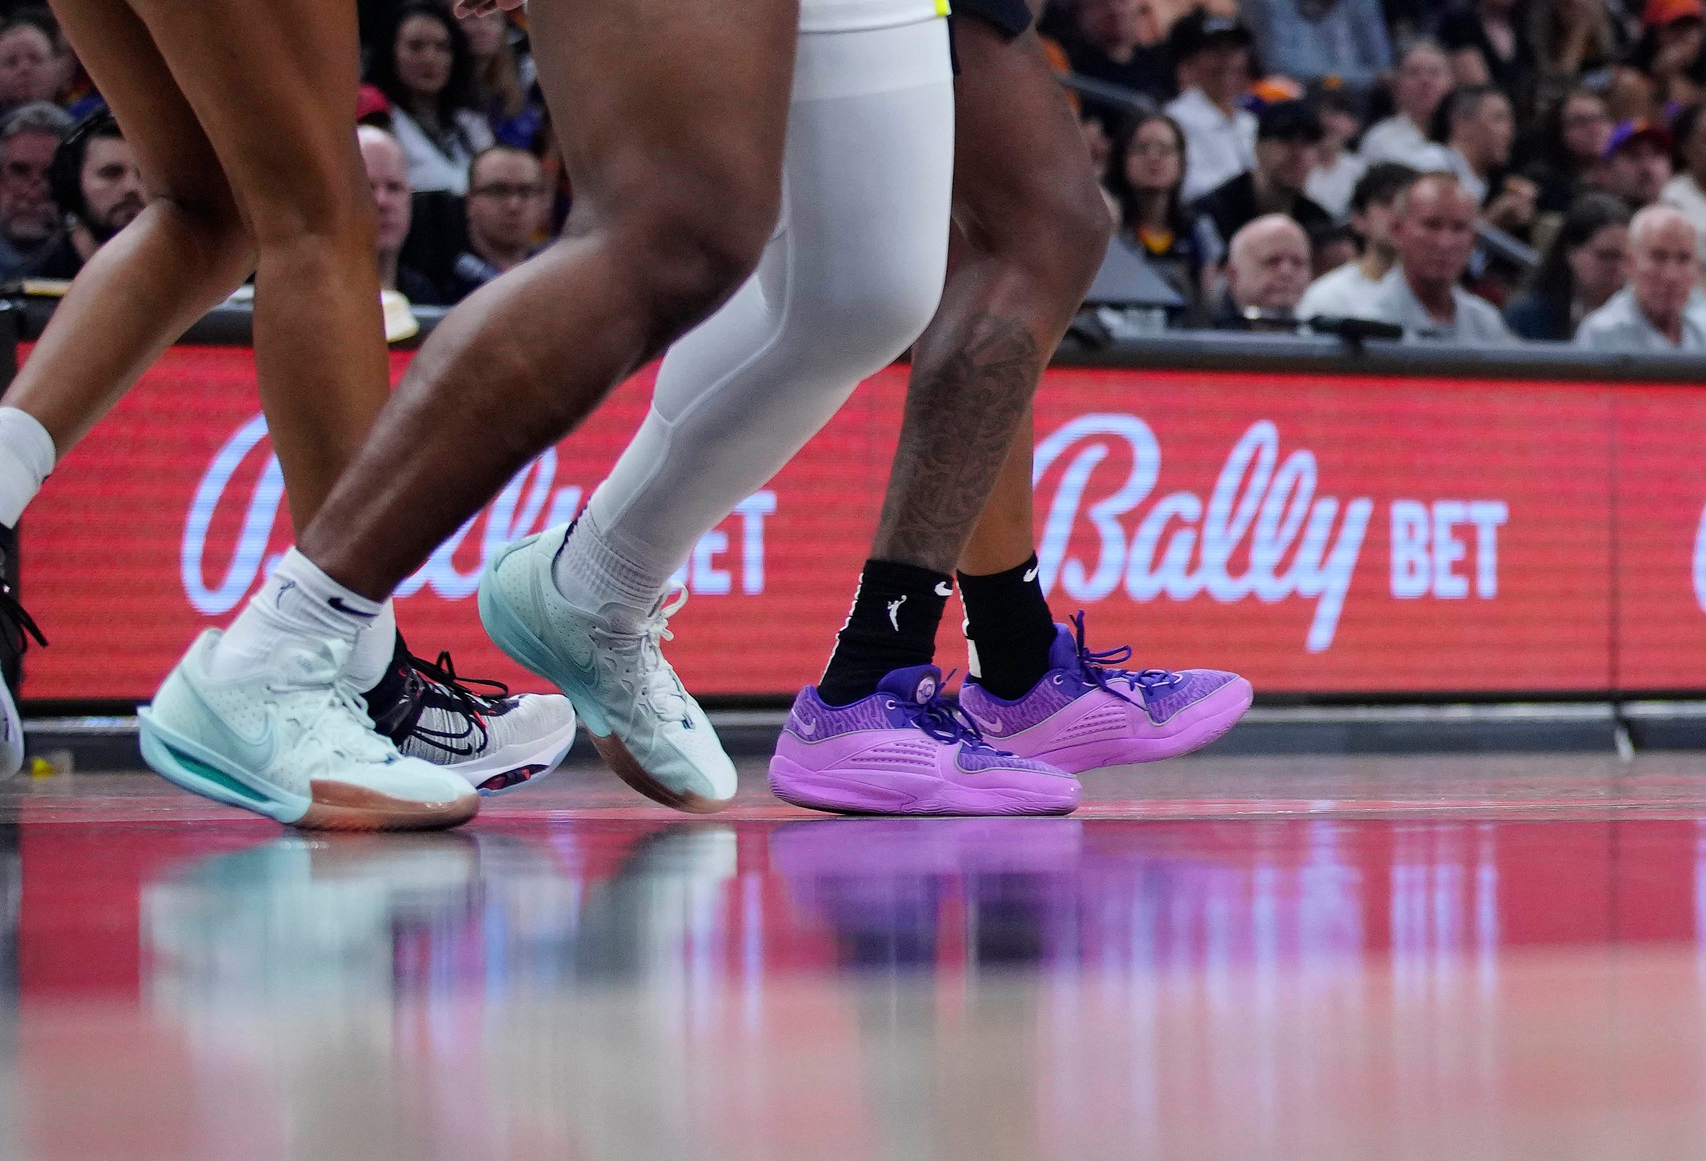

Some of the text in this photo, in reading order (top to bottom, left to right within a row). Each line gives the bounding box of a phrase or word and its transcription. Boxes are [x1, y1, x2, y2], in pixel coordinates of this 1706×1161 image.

[667, 489, 778, 596] ET
[1031, 412, 1510, 654] Bally BET
